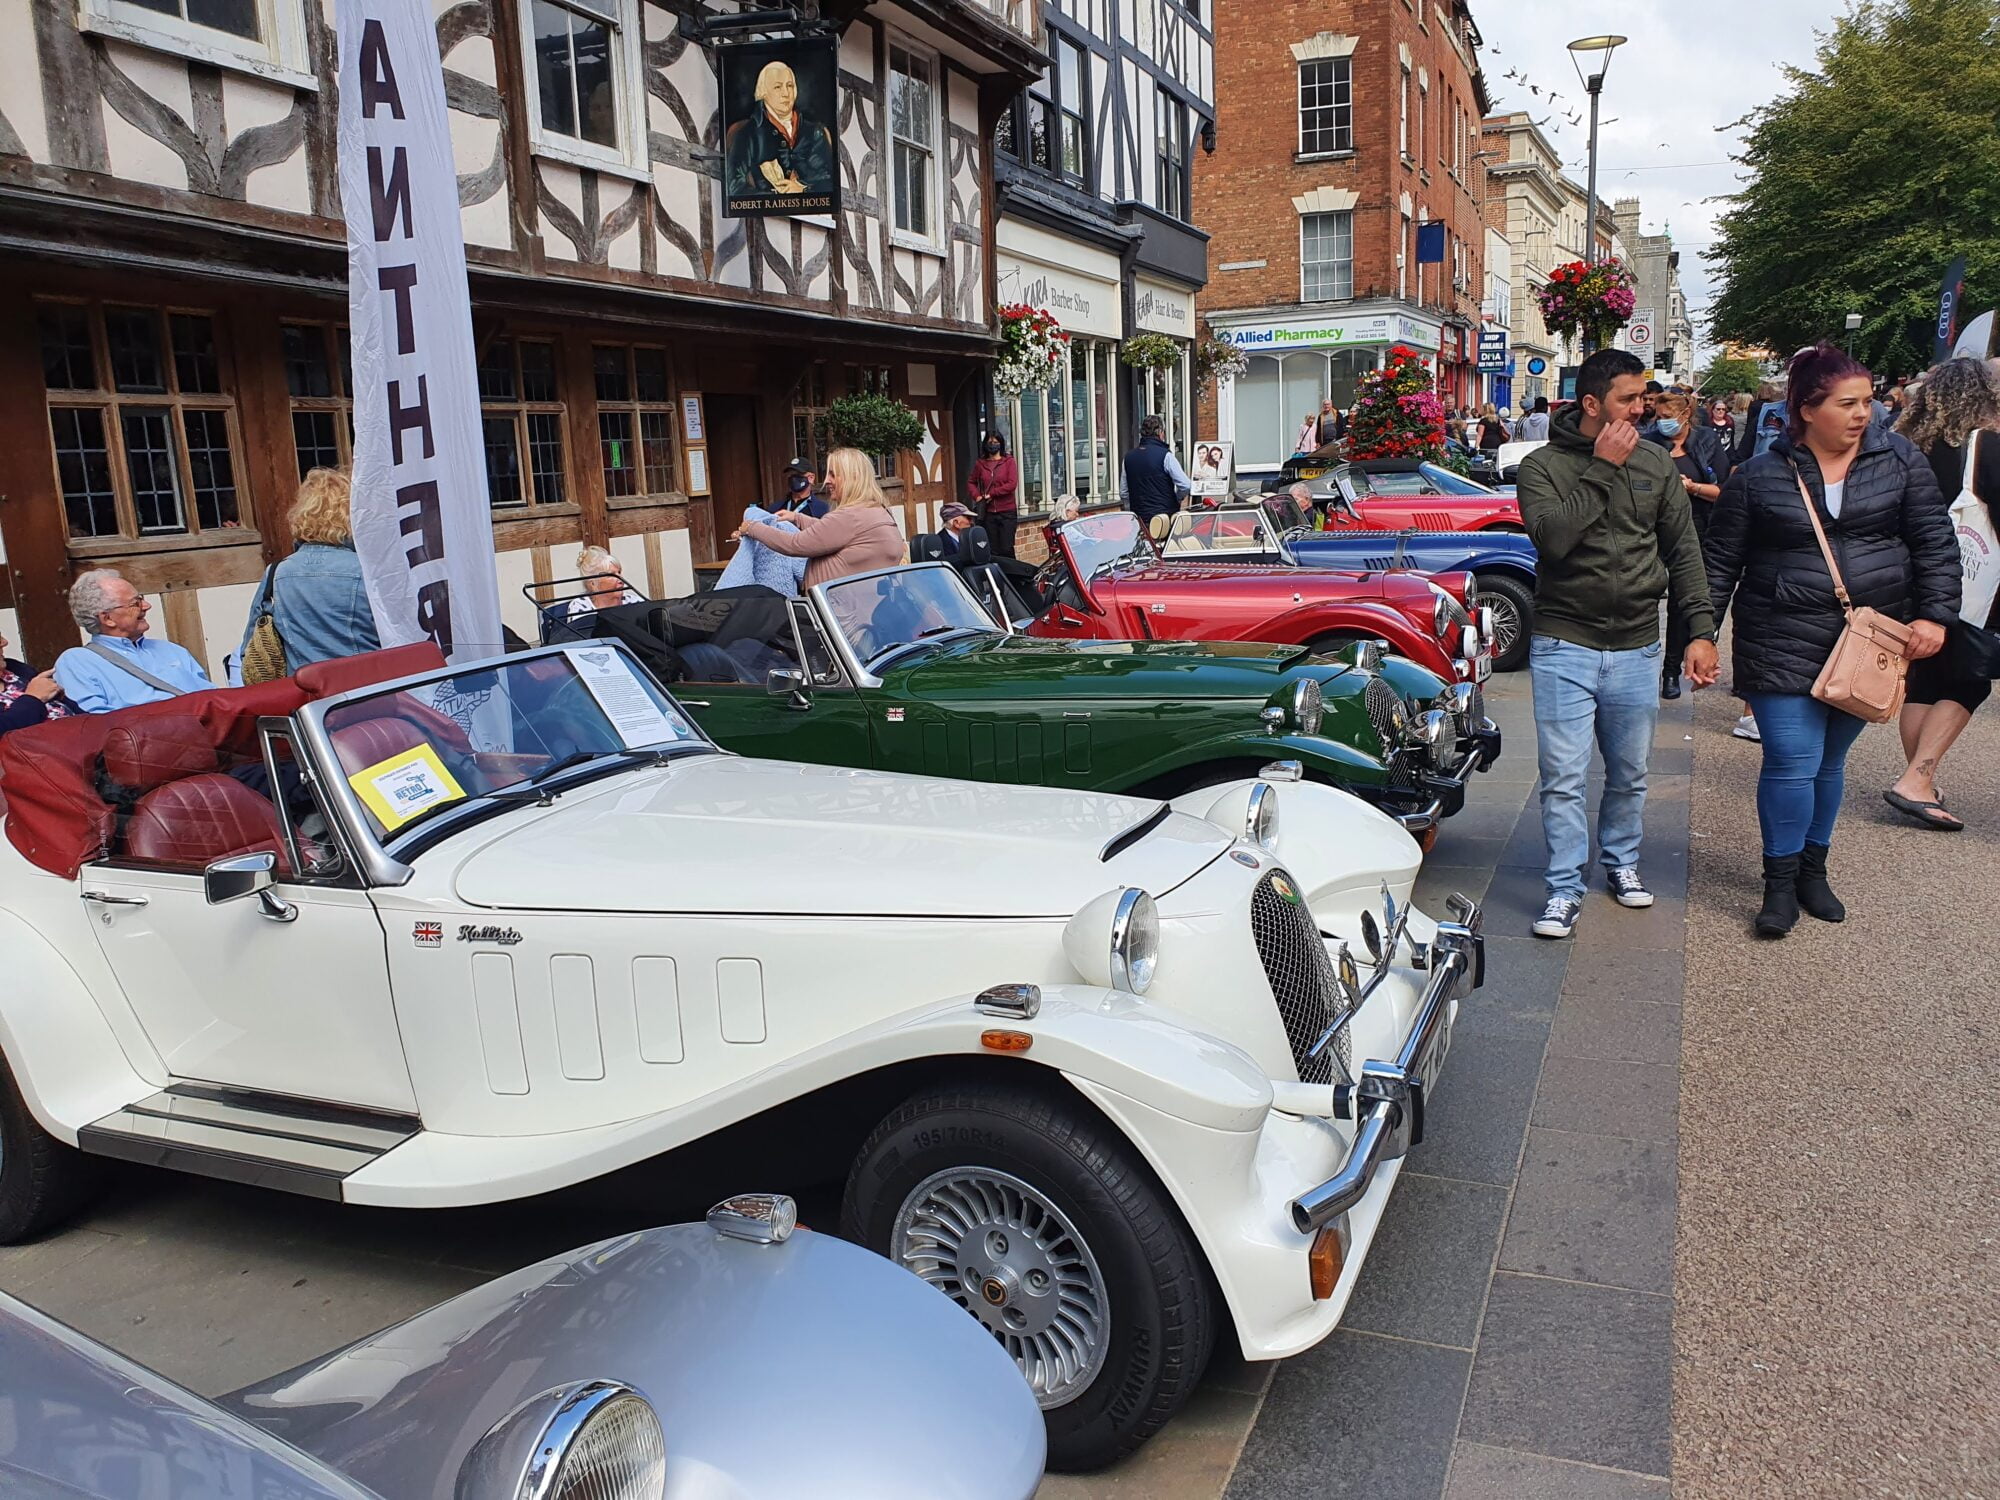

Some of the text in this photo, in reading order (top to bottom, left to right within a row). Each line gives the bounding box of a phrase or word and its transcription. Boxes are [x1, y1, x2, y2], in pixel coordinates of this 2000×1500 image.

[730, 200, 762, 210] ROBERT
[802, 197, 830, 206] HOUSE
[1023, 276, 1090, 318] KARA Barber Shop
[1155, 299, 1165, 316] Hair
[1166, 302, 1171, 316] &
[1235, 327, 1344, 344] Allied Pharmacy
[395, 783, 423, 800] RETRO
[457, 925, 523, 943] Kallista
